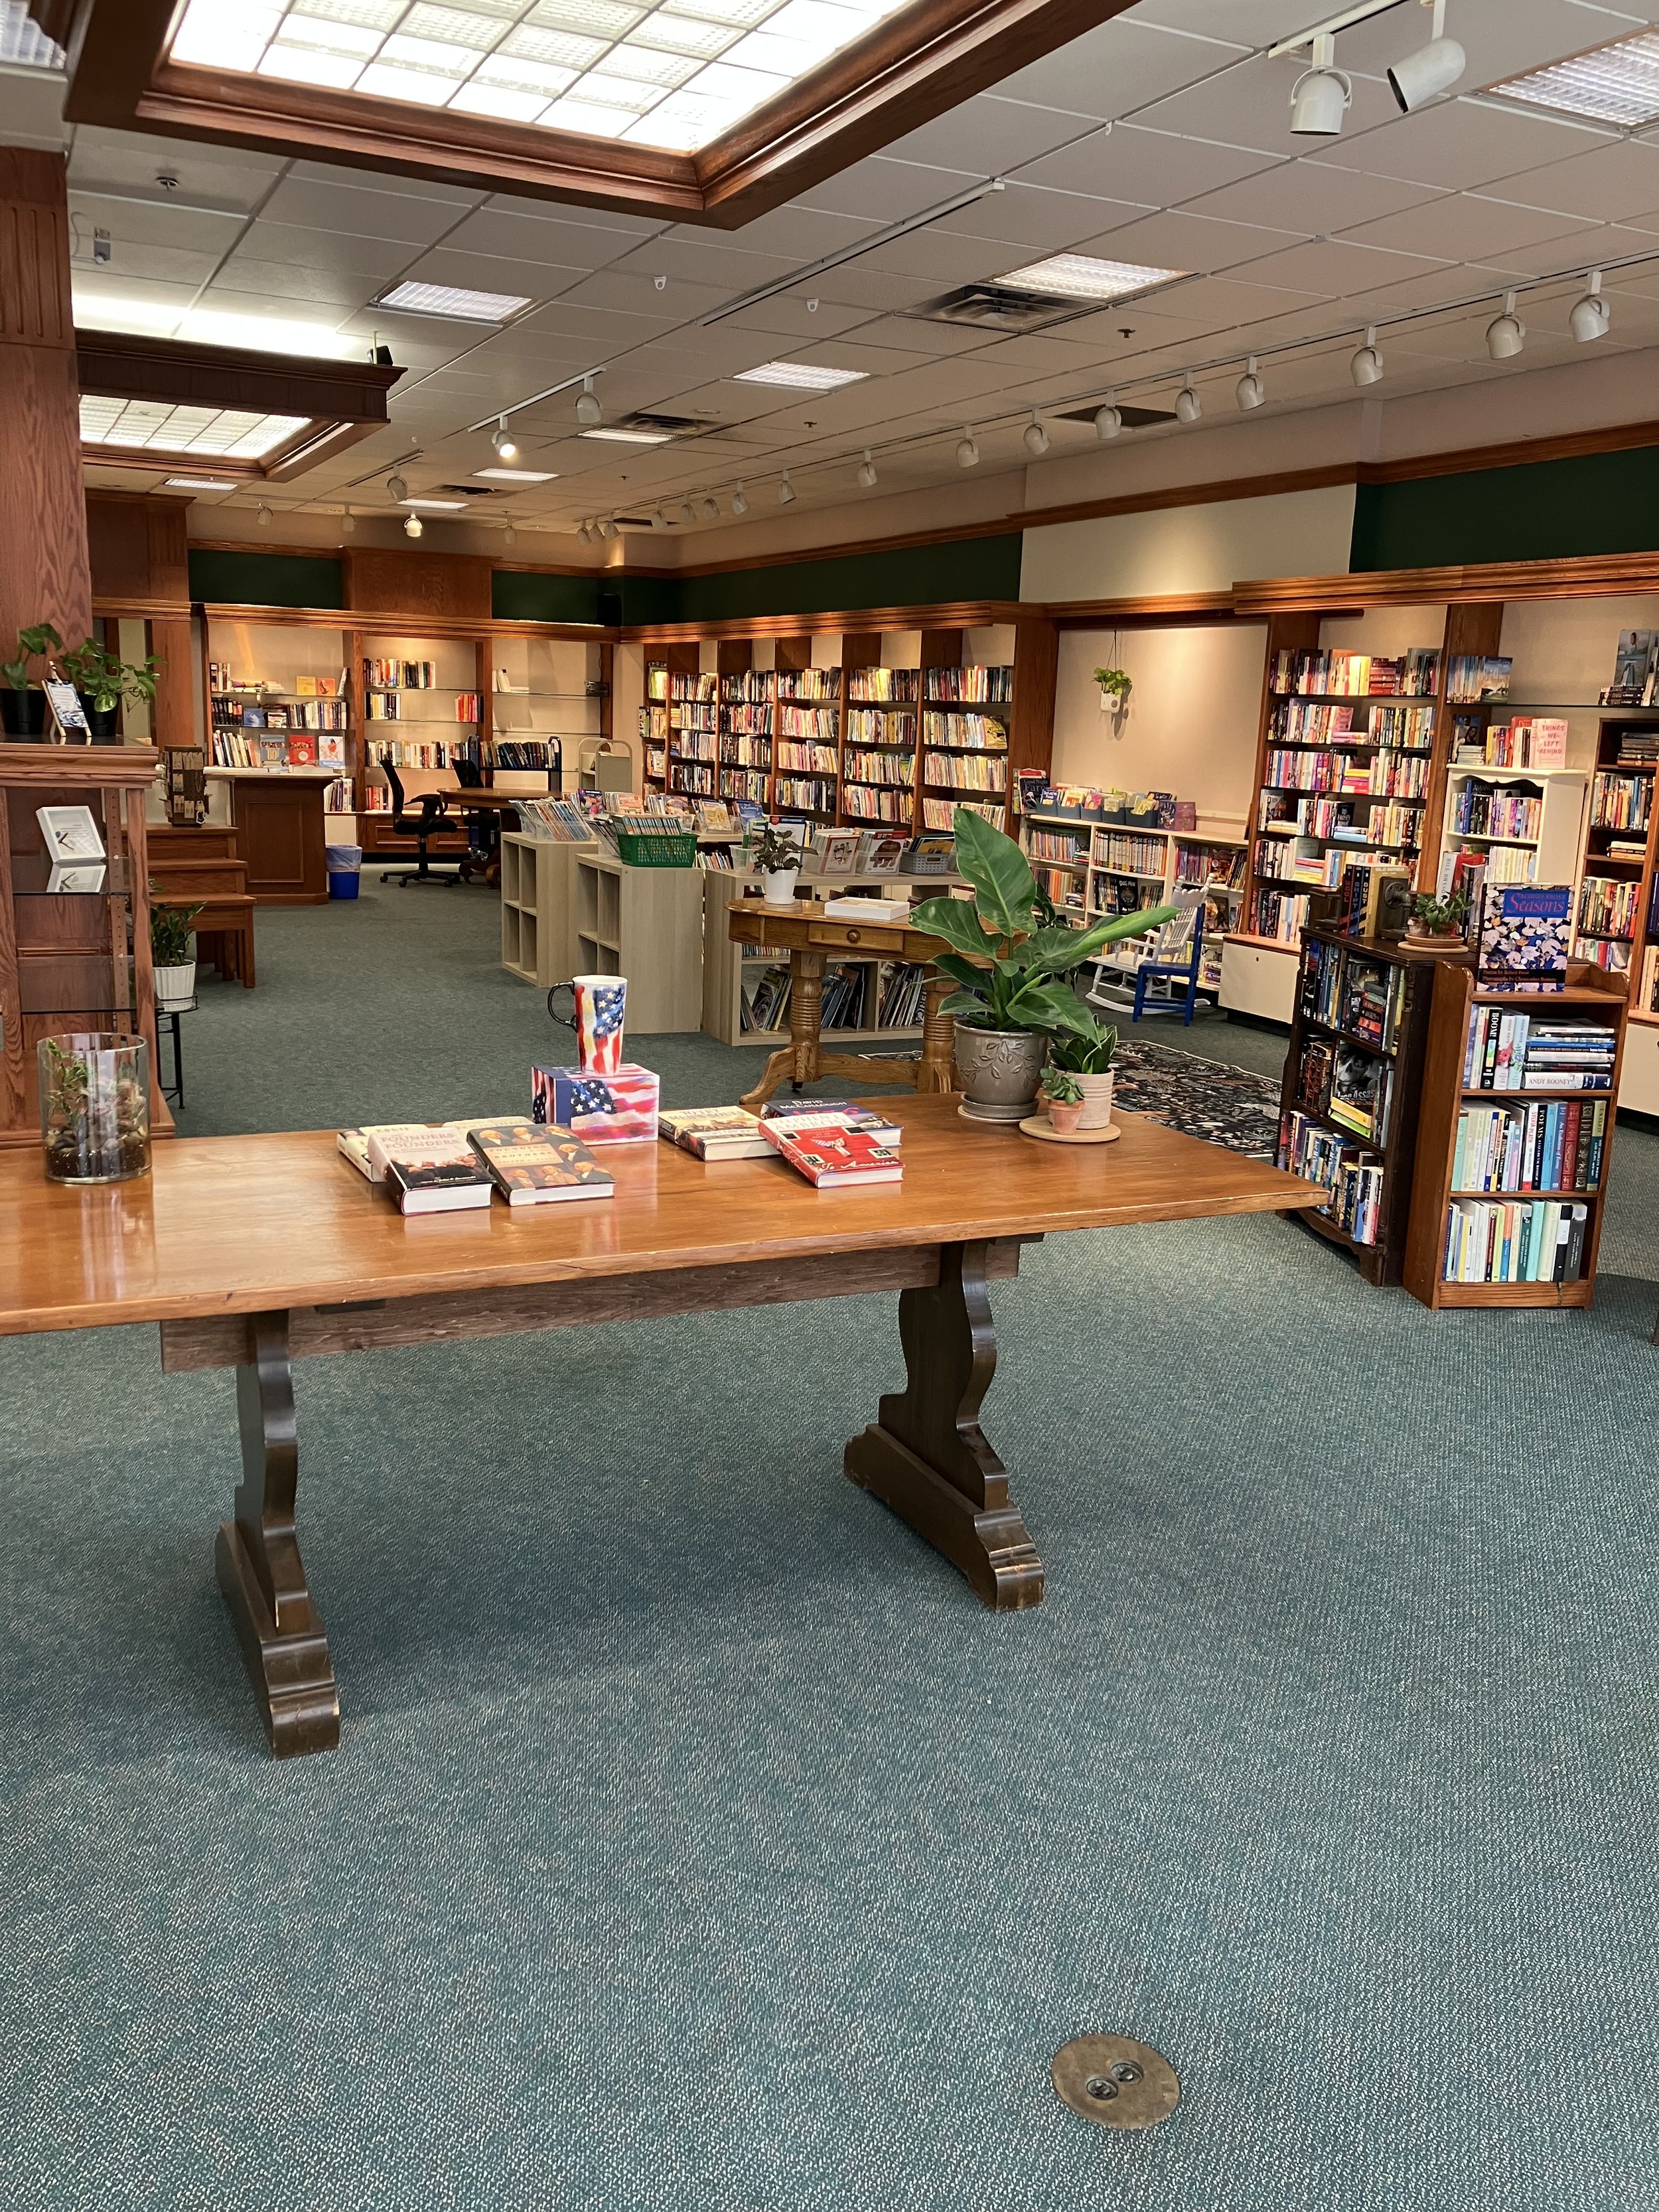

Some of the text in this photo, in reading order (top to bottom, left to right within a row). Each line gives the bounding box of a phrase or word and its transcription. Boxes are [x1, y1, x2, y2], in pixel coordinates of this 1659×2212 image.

[1510, 892, 1565, 913] Seasons
[1489, 1013, 1500, 1037] BOOM!
[776, 1119, 849, 1130] AMBROSE
[380, 1133, 455, 1142] FOUNDERS
[385, 1140, 461, 1149] FOUNDERS
[822, 1162, 835, 1171] To
